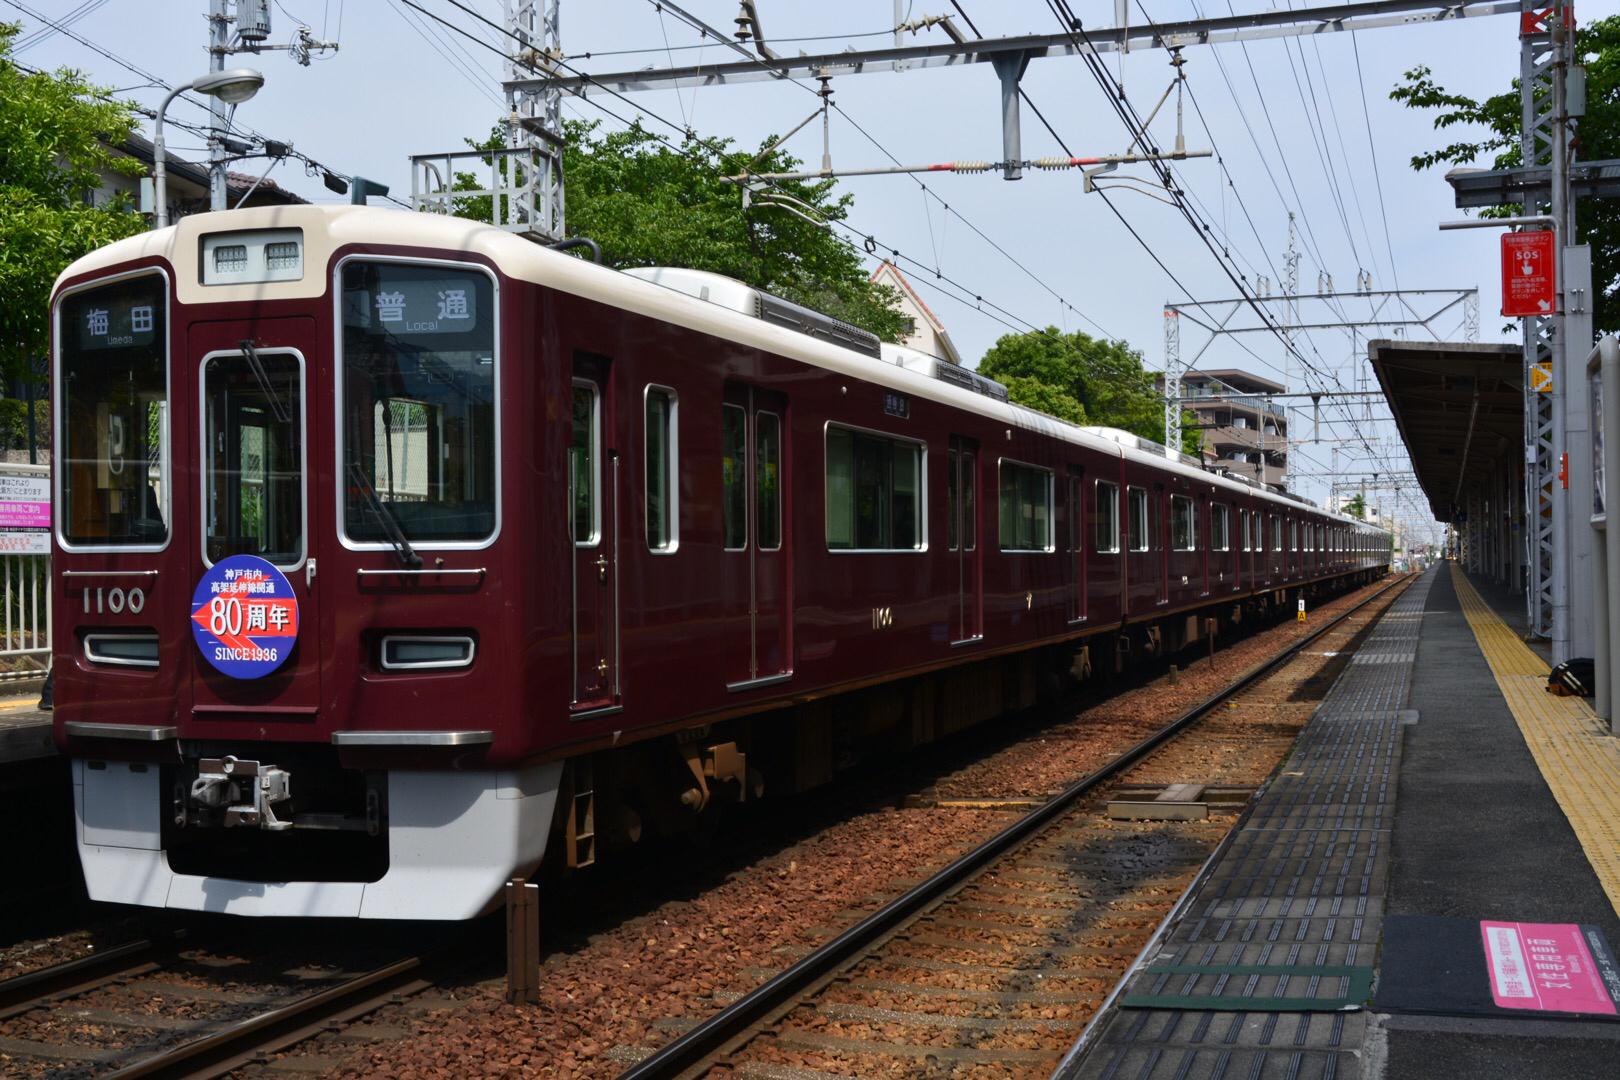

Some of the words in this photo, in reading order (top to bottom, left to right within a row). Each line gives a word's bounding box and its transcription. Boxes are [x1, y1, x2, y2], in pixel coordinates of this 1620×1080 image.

[1515, 251, 1538, 260] SOS
[375, 290, 470, 321] 普通
[86, 305, 153, 336] 梅田
[406, 321, 438, 331] Local
[225, 568, 263, 581] 神戸市内
[84, 587, 145, 614] 1100
